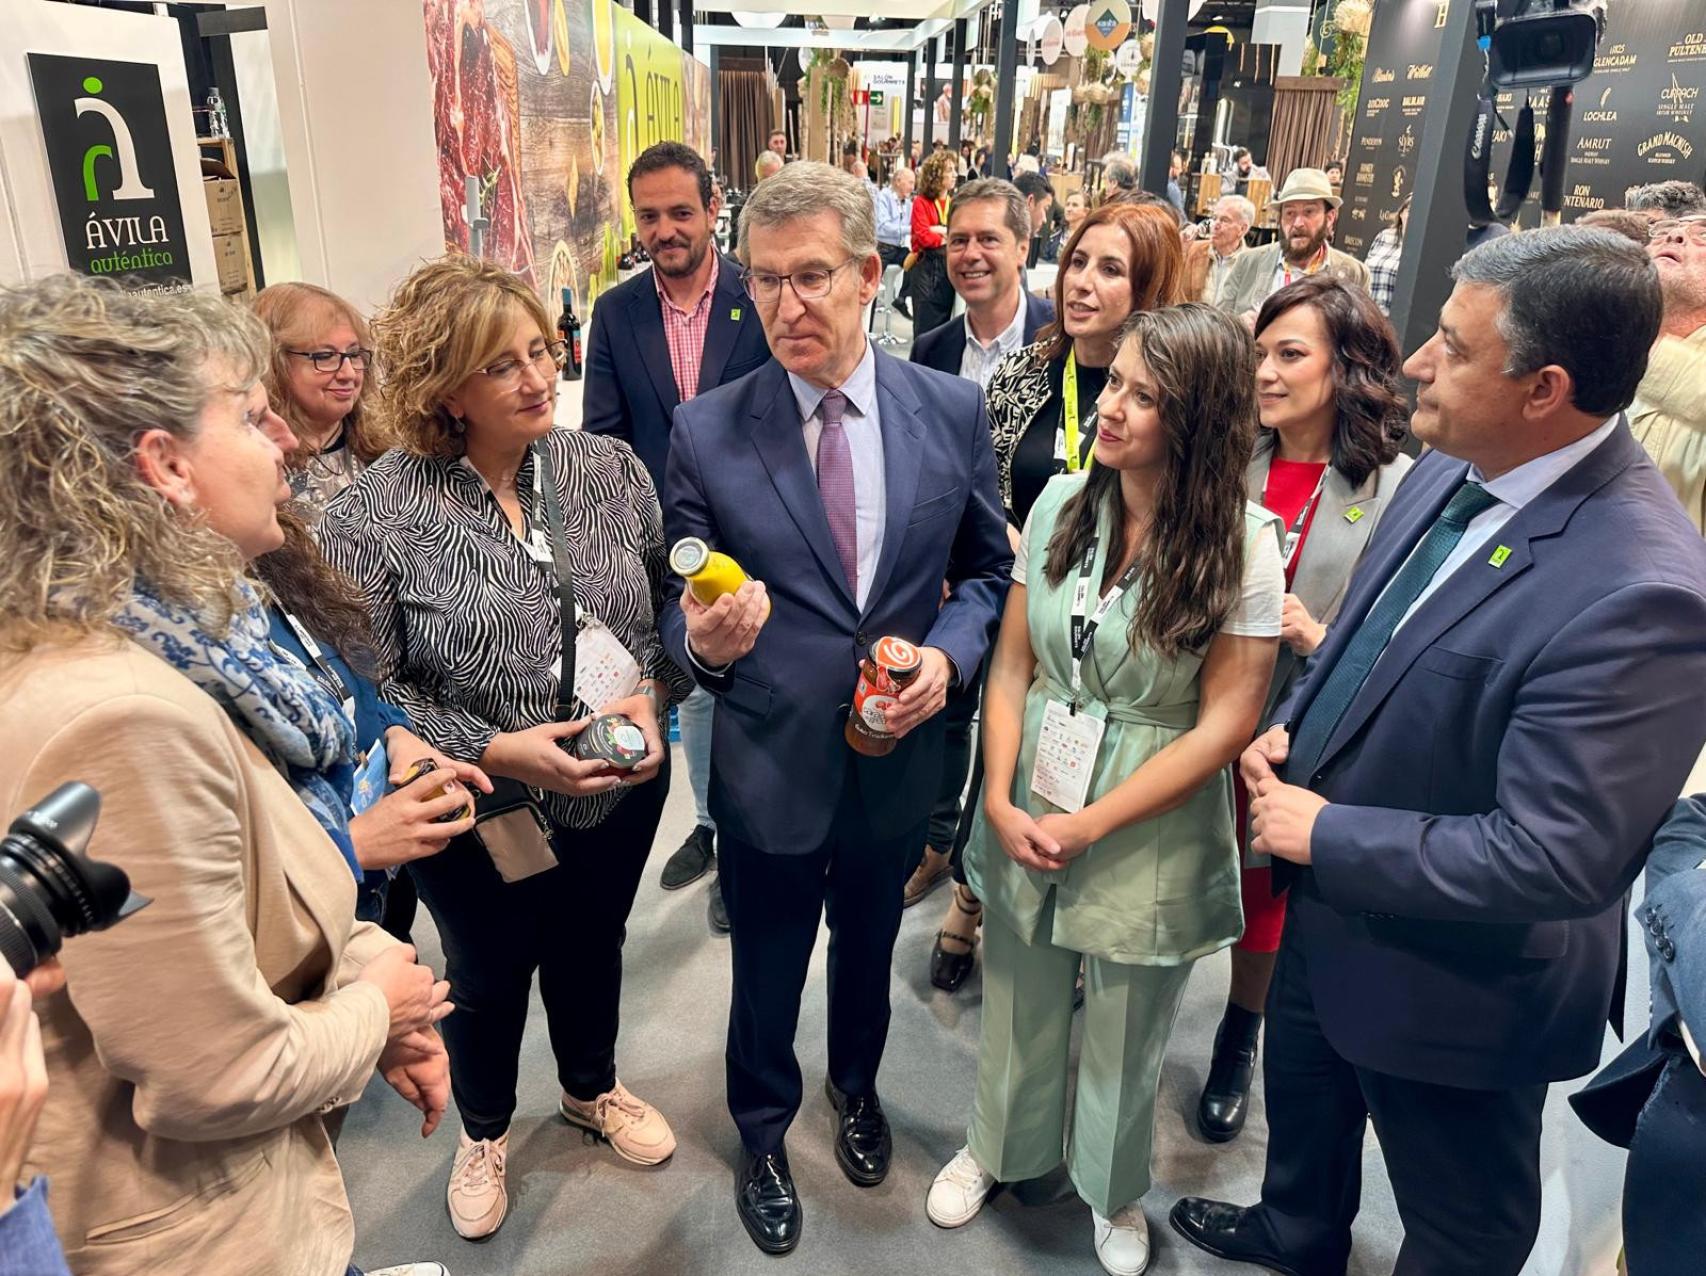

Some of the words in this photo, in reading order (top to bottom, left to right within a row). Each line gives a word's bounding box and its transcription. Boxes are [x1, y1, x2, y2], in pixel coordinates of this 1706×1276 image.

[1684, 33, 1704, 45] OLD
[1668, 44, 1706, 57] PULTENE
[1593, 55, 1637, 67] GLENCADAM
[1583, 111, 1617, 121] LOCHLEA
[1576, 137, 1612, 150] AMRUT
[1637, 134, 1663, 157] GRAND
[1573, 184, 1591, 196] RON
[1564, 195, 1605, 209] NTENARIO
[85, 211, 169, 249] ÁVILA
[90, 248, 173, 274] auténtica
